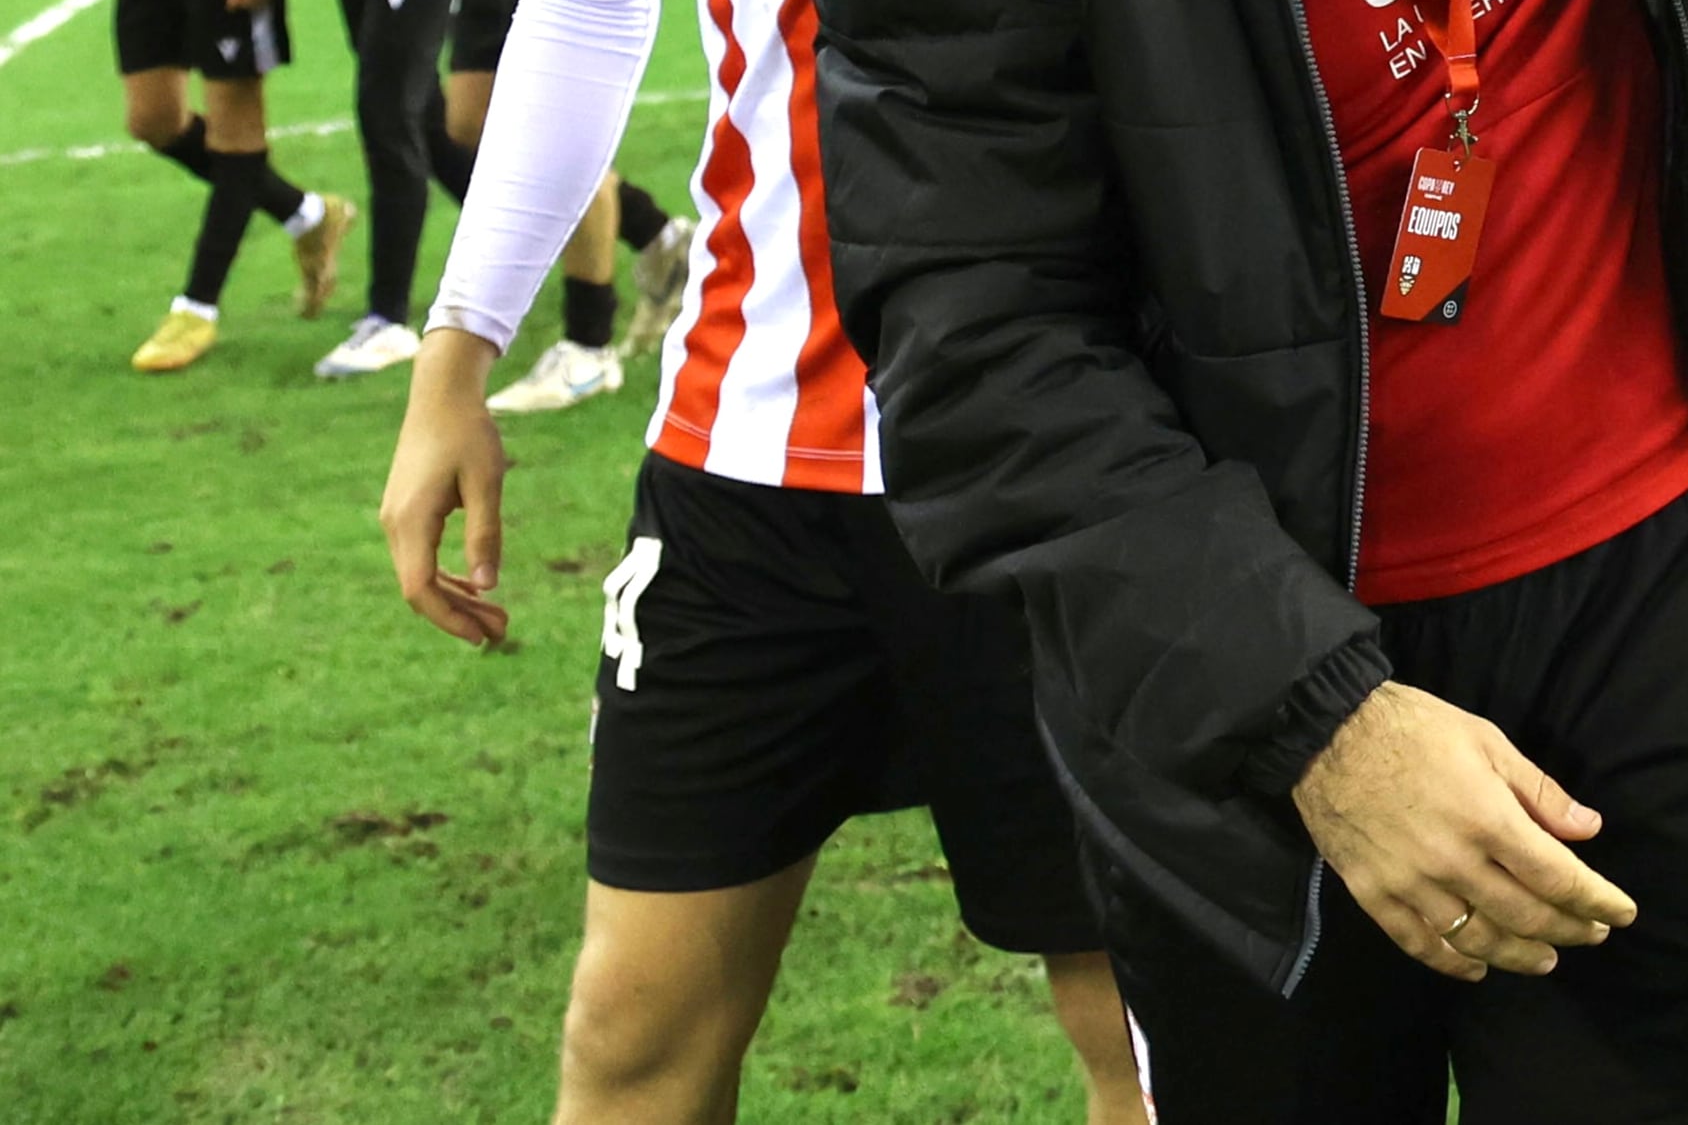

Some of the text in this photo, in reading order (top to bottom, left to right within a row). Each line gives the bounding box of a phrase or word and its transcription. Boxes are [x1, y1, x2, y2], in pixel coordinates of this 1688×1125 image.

[1379, 18, 1413, 52] LA
[1389, 40, 1427, 80] EN
[1407, 205, 1462, 240] EQUIPOS
